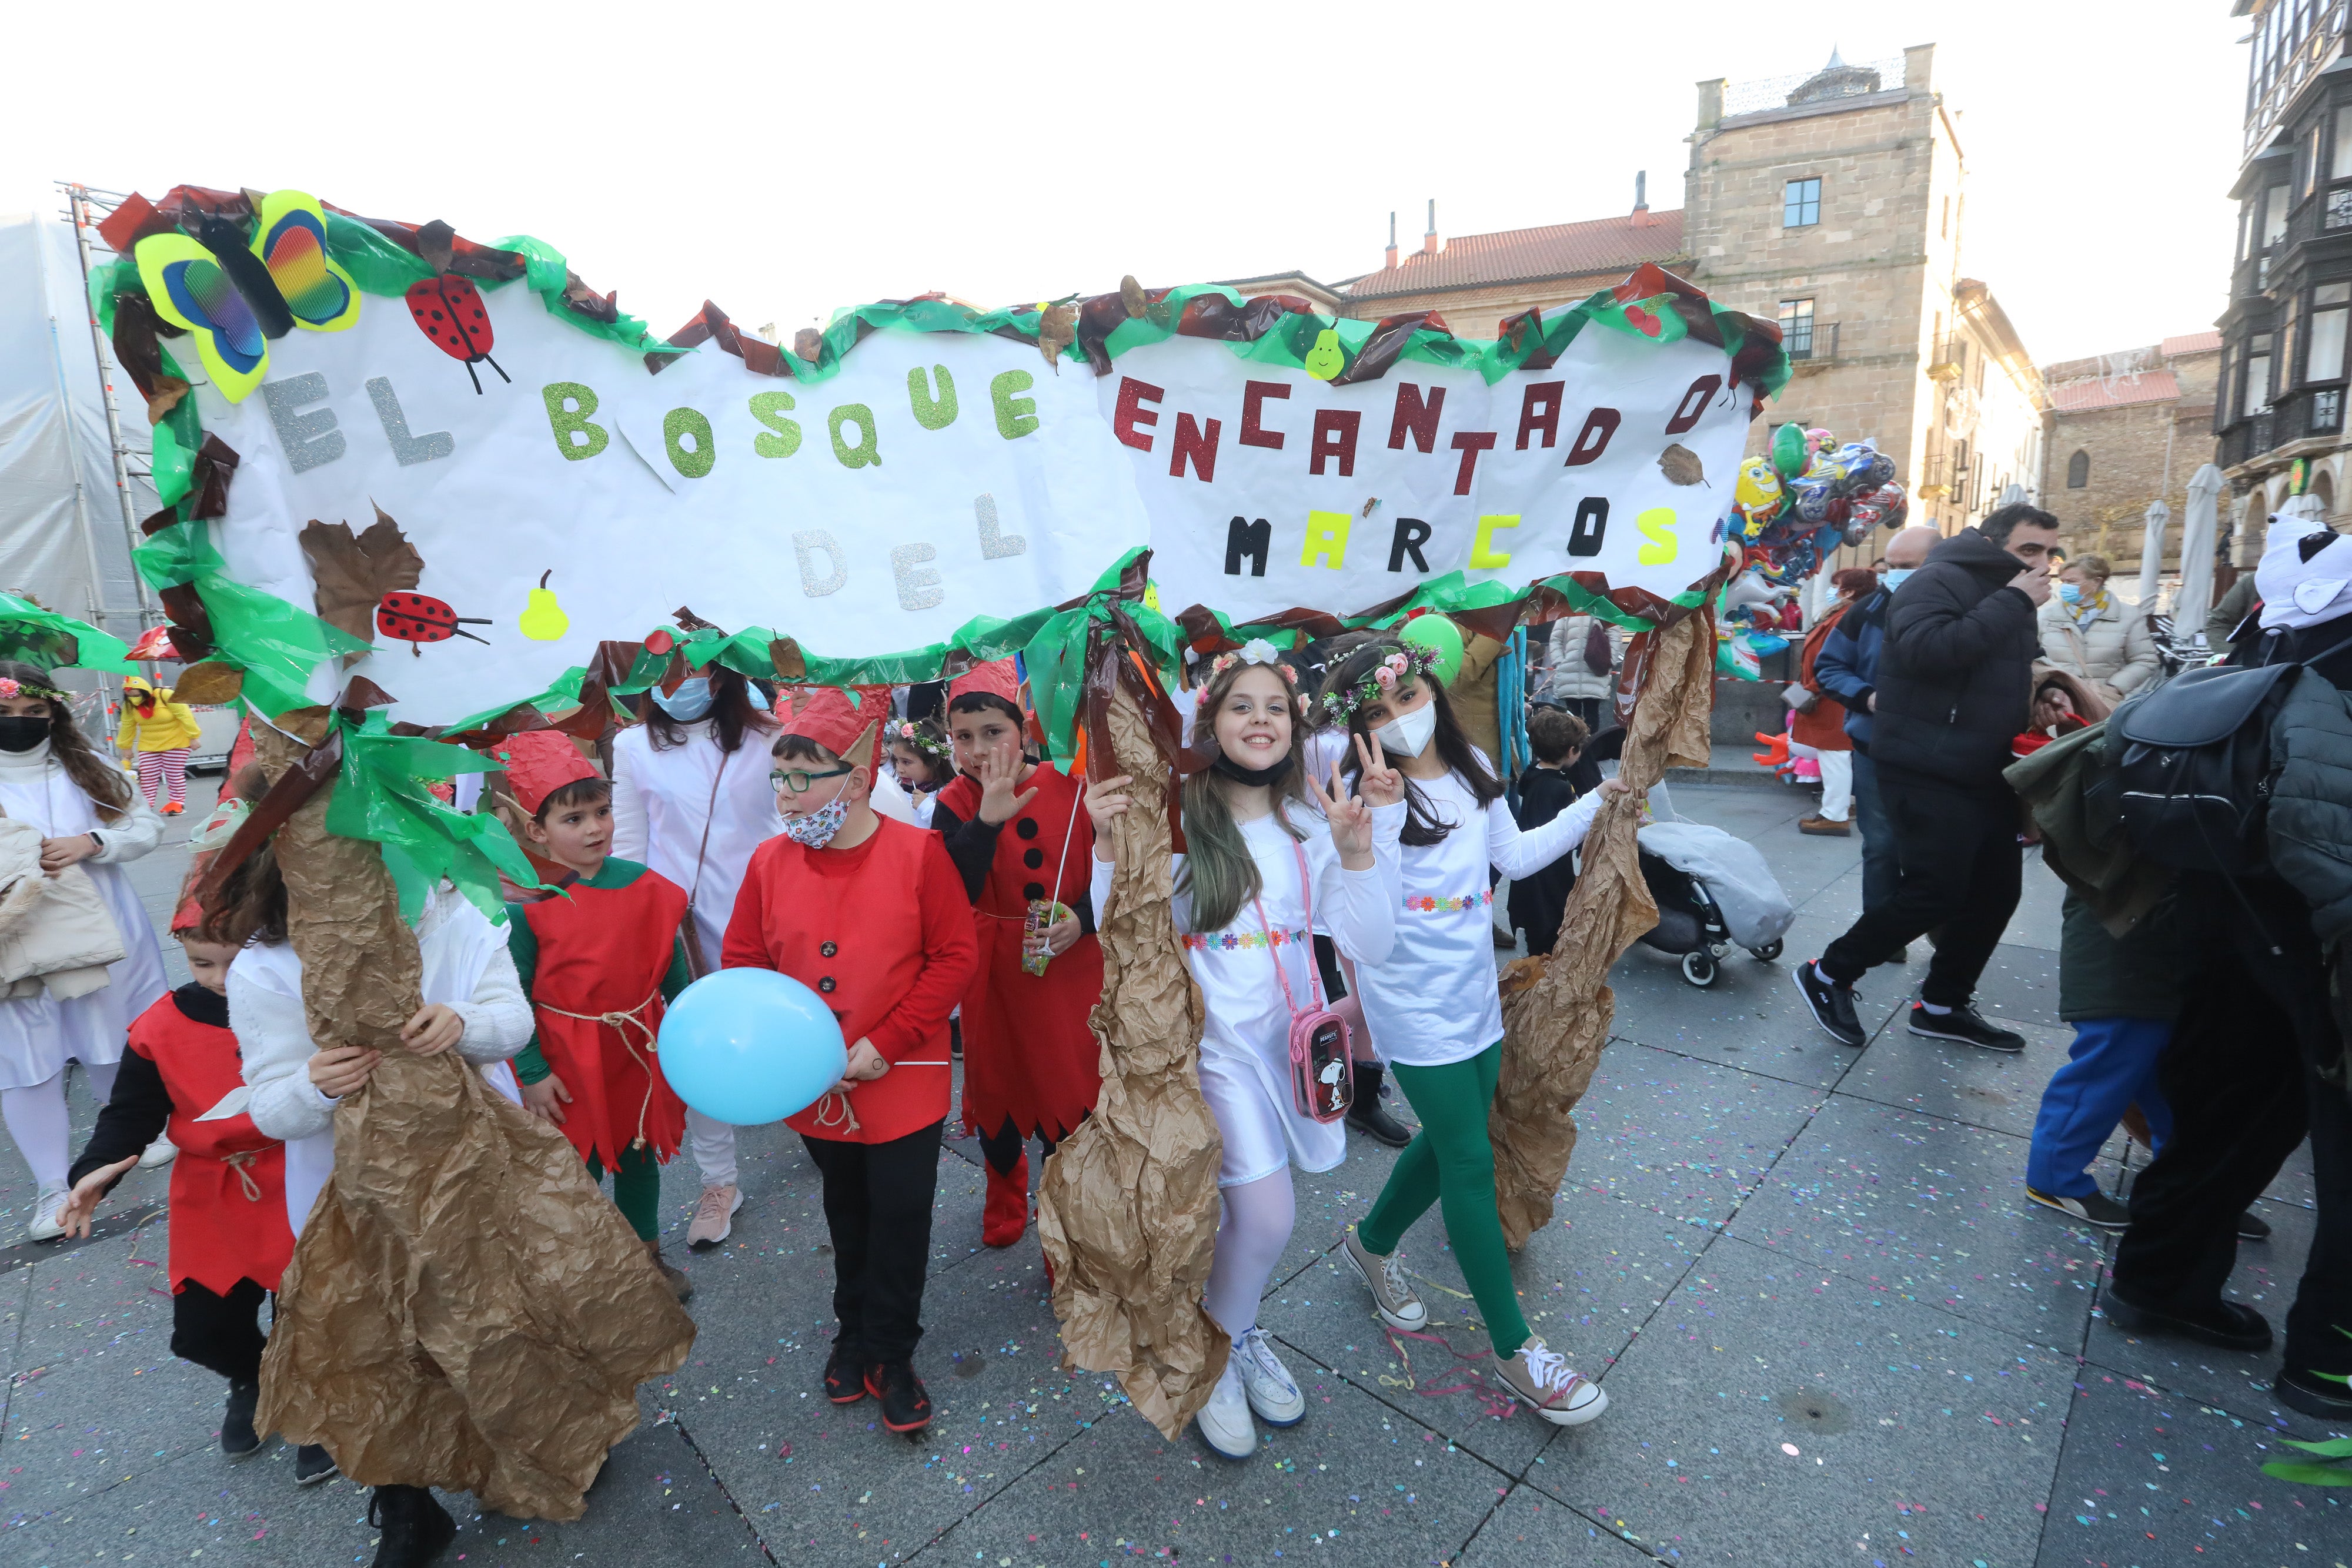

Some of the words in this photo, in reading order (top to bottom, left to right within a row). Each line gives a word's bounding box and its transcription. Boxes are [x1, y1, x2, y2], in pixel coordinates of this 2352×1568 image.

[261, 370, 455, 474] EL
[542, 364, 1040, 479] BOSQUE
[1113, 374, 1722, 496] ENCANTADO
[791, 492, 1027, 611] DEL
[1224, 496, 1678, 577] MARCOS
[1819, 992, 1828, 1003] FILA
[1320, 1032, 1336, 1042] PEANUTS
